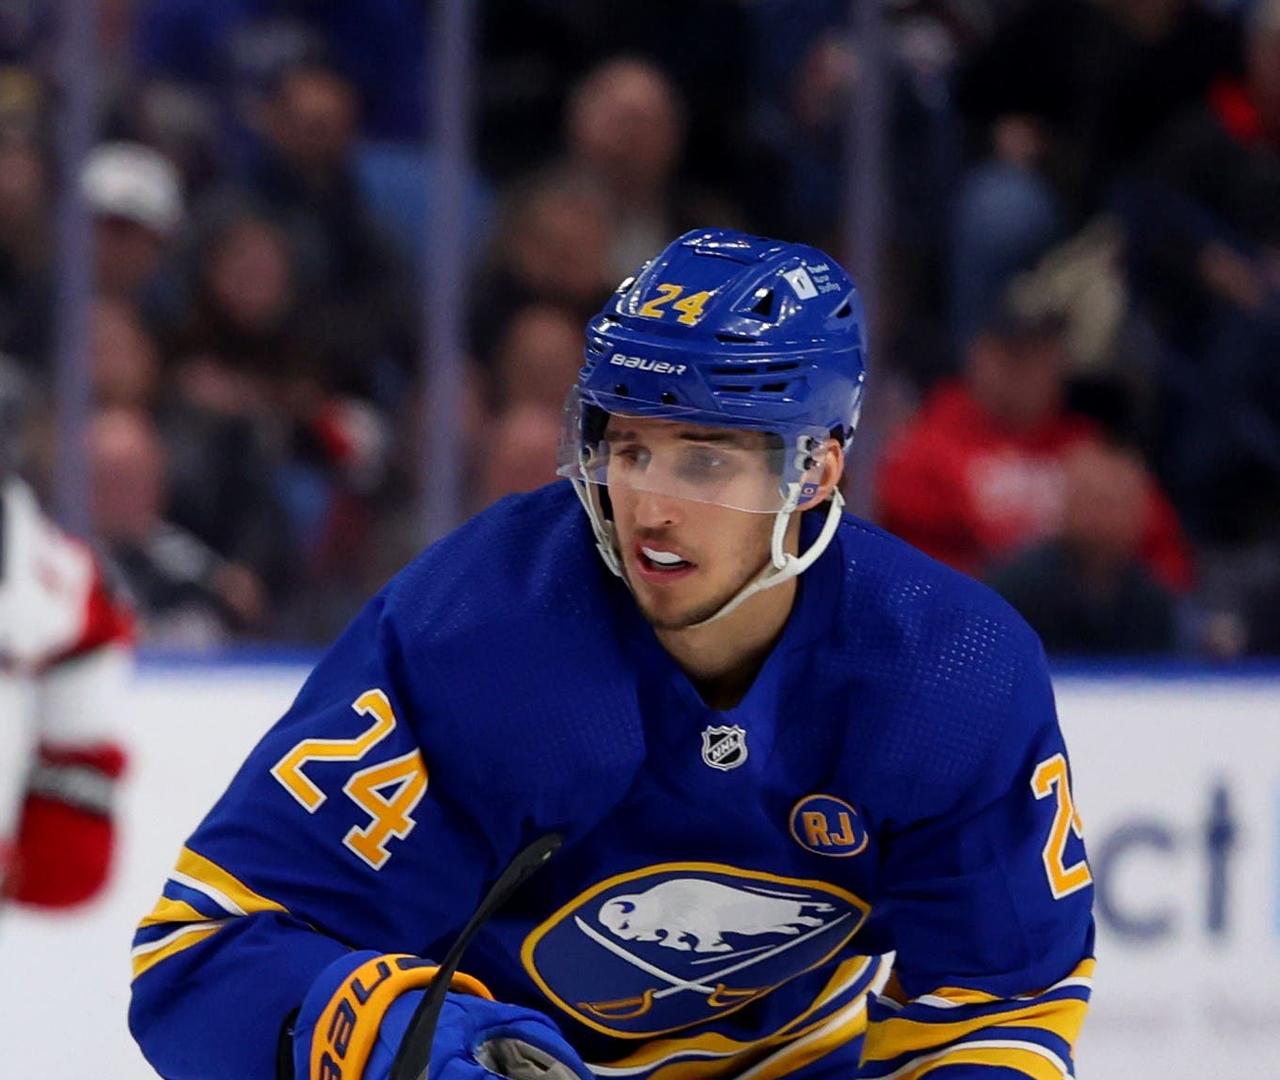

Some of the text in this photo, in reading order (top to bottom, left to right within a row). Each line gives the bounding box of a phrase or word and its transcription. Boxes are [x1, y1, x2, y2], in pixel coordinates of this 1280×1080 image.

[640, 283, 712, 327] 24
[711, 735, 739, 761] NHL
[269, 688, 429, 871] 24
[801, 811, 855, 846] RJ
[1030, 752, 1093, 900] 2
